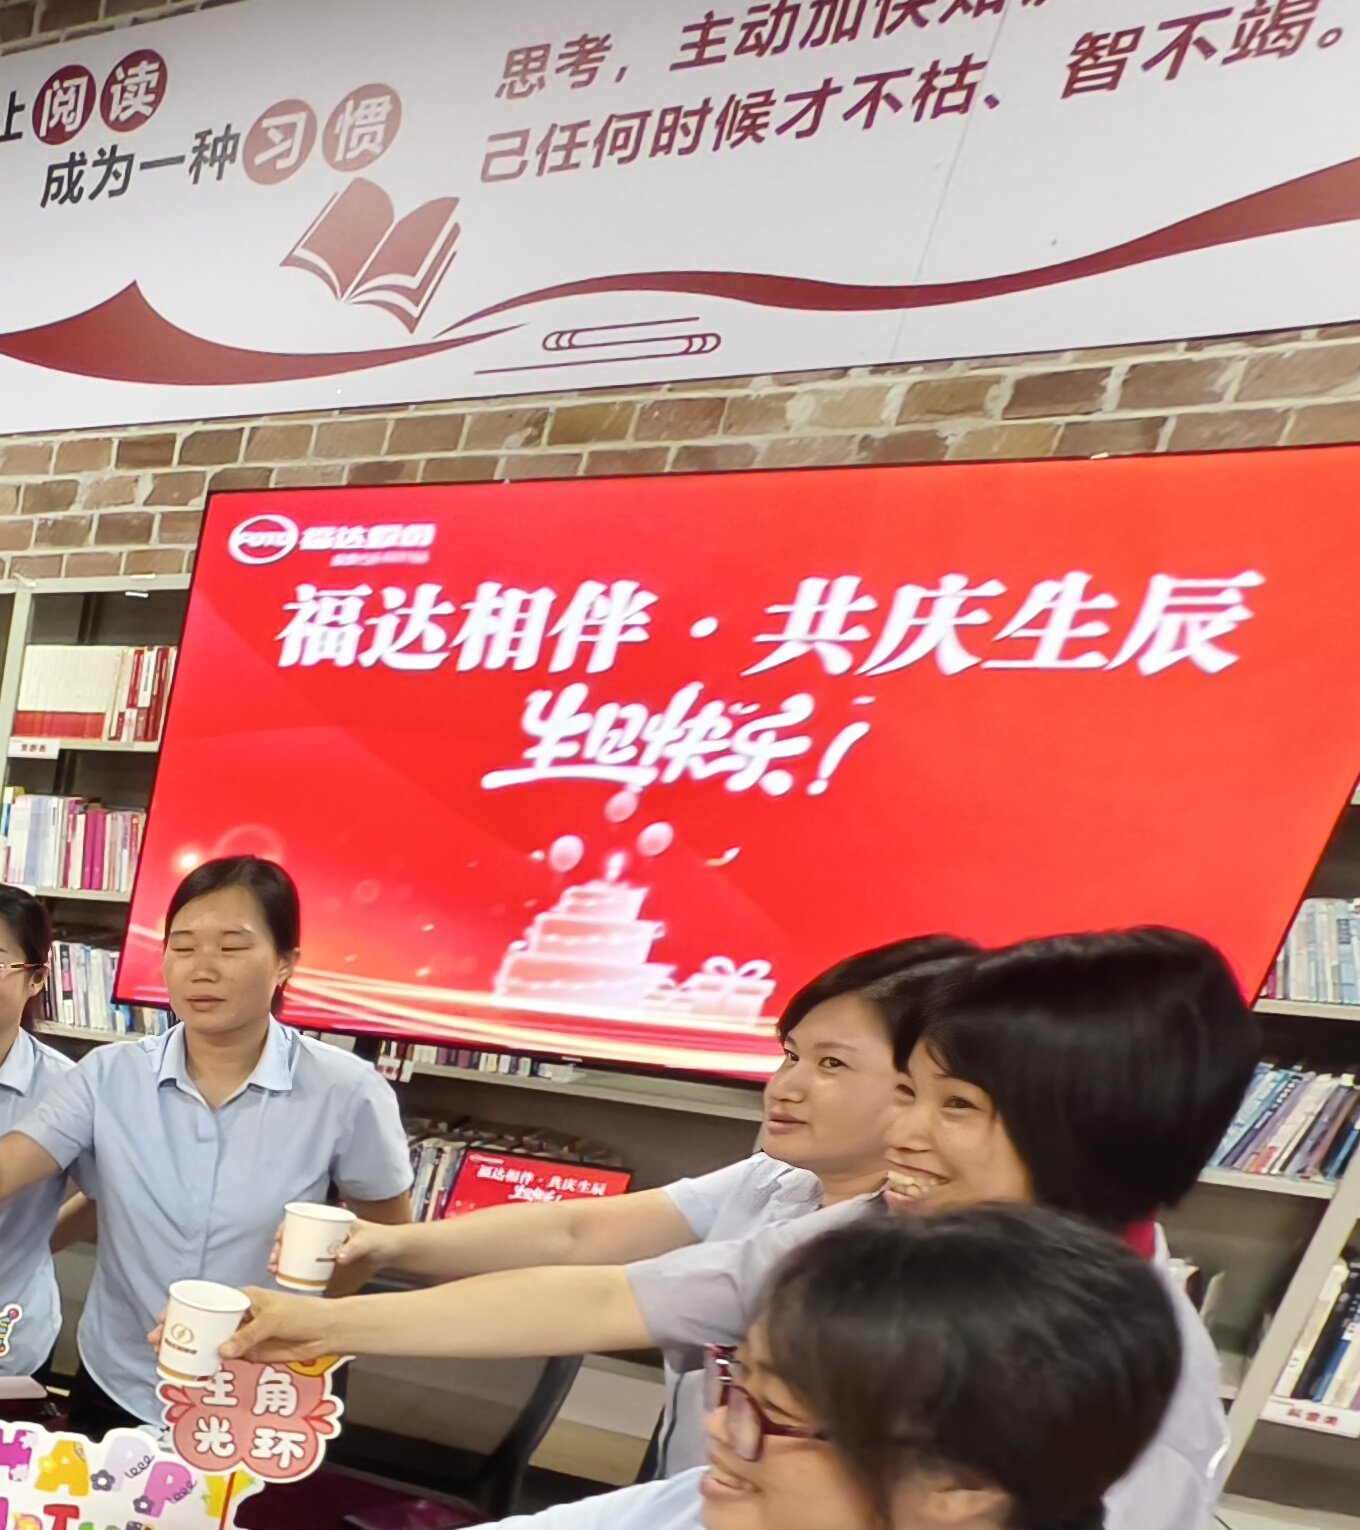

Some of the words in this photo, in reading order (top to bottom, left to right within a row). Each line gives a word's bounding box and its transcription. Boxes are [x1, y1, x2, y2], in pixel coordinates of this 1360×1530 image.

[496, 0, 1046, 99] 思考,主动加快
[40, 94, 393, 208] 成为一种习惯
[192, 1416, 307, 1469] 光环
